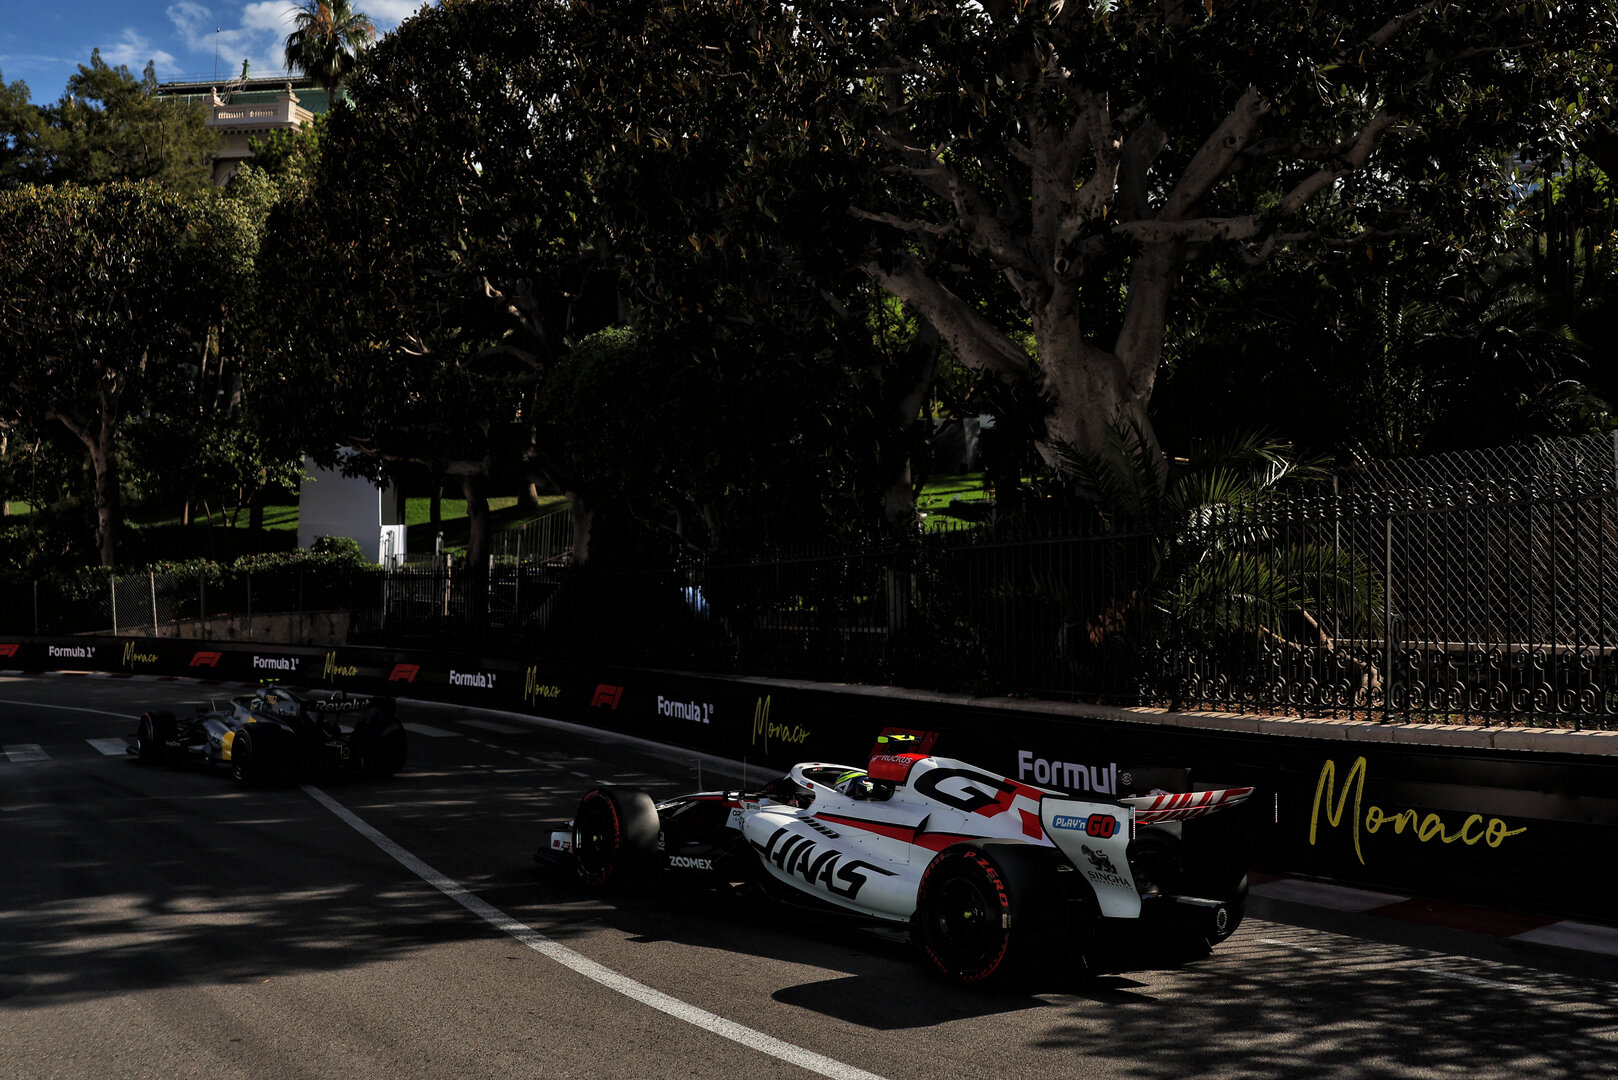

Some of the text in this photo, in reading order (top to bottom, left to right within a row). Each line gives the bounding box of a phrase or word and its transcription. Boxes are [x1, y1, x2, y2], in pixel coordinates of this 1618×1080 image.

[49, 645, 86, 657] Formula
[122, 641, 158, 669] Monaco
[253, 656, 290, 670] Formula
[323, 650, 359, 684] Monaco
[450, 669, 486, 688] Formula
[524, 665, 561, 707] Monaco
[315, 698, 371, 713] Revolut
[657, 695, 701, 722] Formula
[752, 694, 811, 756] Monaco
[881, 754, 913, 765] RUCKUS
[1018, 749, 1117, 795] Formul
[1309, 756, 1528, 866] Monaco
[1055, 817, 1115, 836] PLAY'n GO
[669, 855, 713, 870] ZOOMEX
[751, 827, 900, 900] HAAS
[1087, 871, 1131, 887] SINGHA
